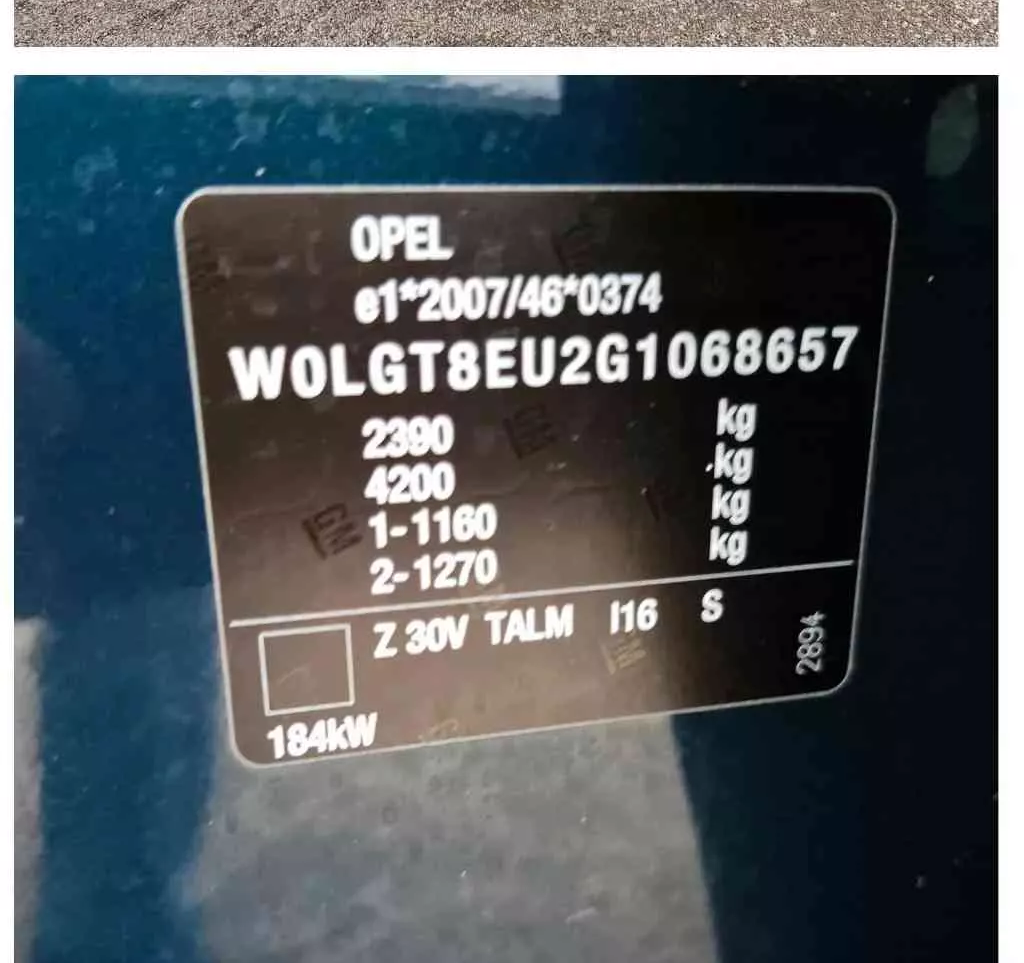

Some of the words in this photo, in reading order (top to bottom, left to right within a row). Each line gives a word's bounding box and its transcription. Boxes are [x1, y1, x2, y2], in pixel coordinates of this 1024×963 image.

[350, 214, 454, 262] OPEL
[361, 414, 455, 459] 2390
[716, 397, 757, 442] kg
[363, 461, 456, 505] 4200
[713, 441, 754, 485] kg
[368, 502, 498, 549] 1-1160
[711, 483, 751, 525] kg
[369, 548, 498, 595] 2-1270
[708, 525, 748, 566] kg
[373, 622, 397, 658] Z
[405, 614, 469, 655] 30V
[484, 604, 574, 645] TALM
[701, 588, 724, 623] S
[796, 611, 825, 675] 2894
[267, 712, 378, 759] 184kW
